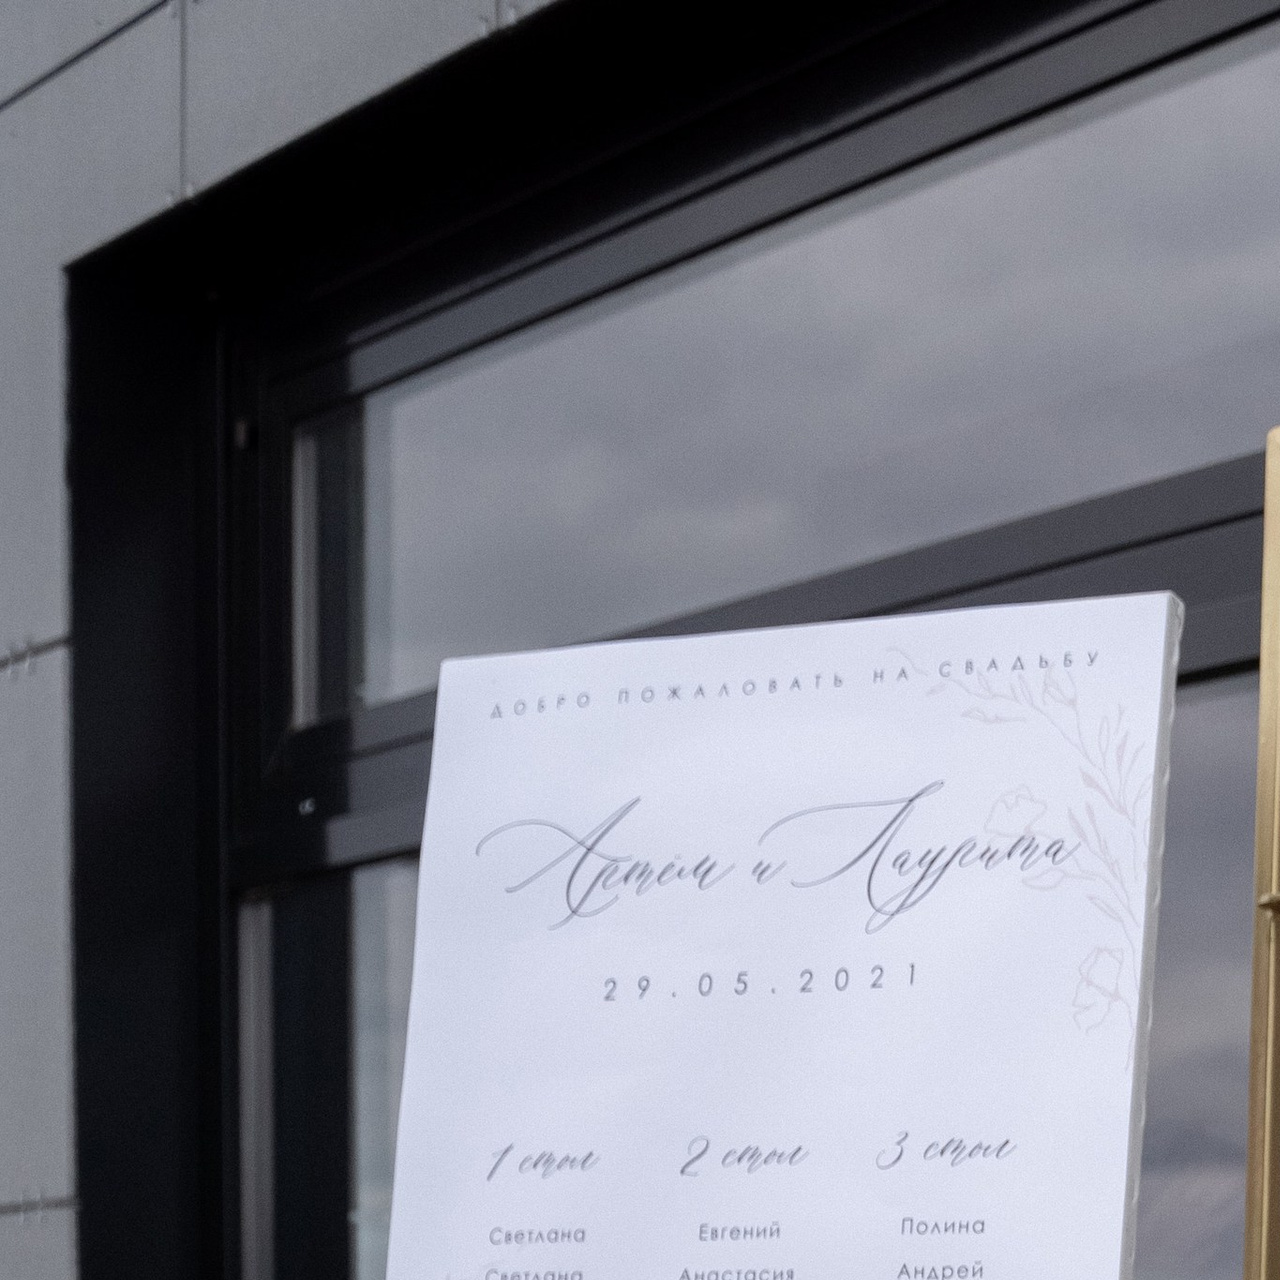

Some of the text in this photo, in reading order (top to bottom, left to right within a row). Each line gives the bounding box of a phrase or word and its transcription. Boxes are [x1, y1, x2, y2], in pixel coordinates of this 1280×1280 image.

[488, 651, 1099, 720] ДОБРО ПОЖАЛОВАТЬ НА СВАДЬБУ
[750, 857, 786, 885] и
[757, 779, 1082, 934] Лаурита
[602, 962, 917, 1003] 29.05.2021
[485, 1143, 599, 1182] 1 стол
[678, 1138, 810, 1177] 2 стол
[876, 1130, 1018, 1171] 3 стол
[488, 1226, 587, 1246] Светлана
[697, 1221, 782, 1242] Евгений
[900, 1216, 987, 1236] Полина
